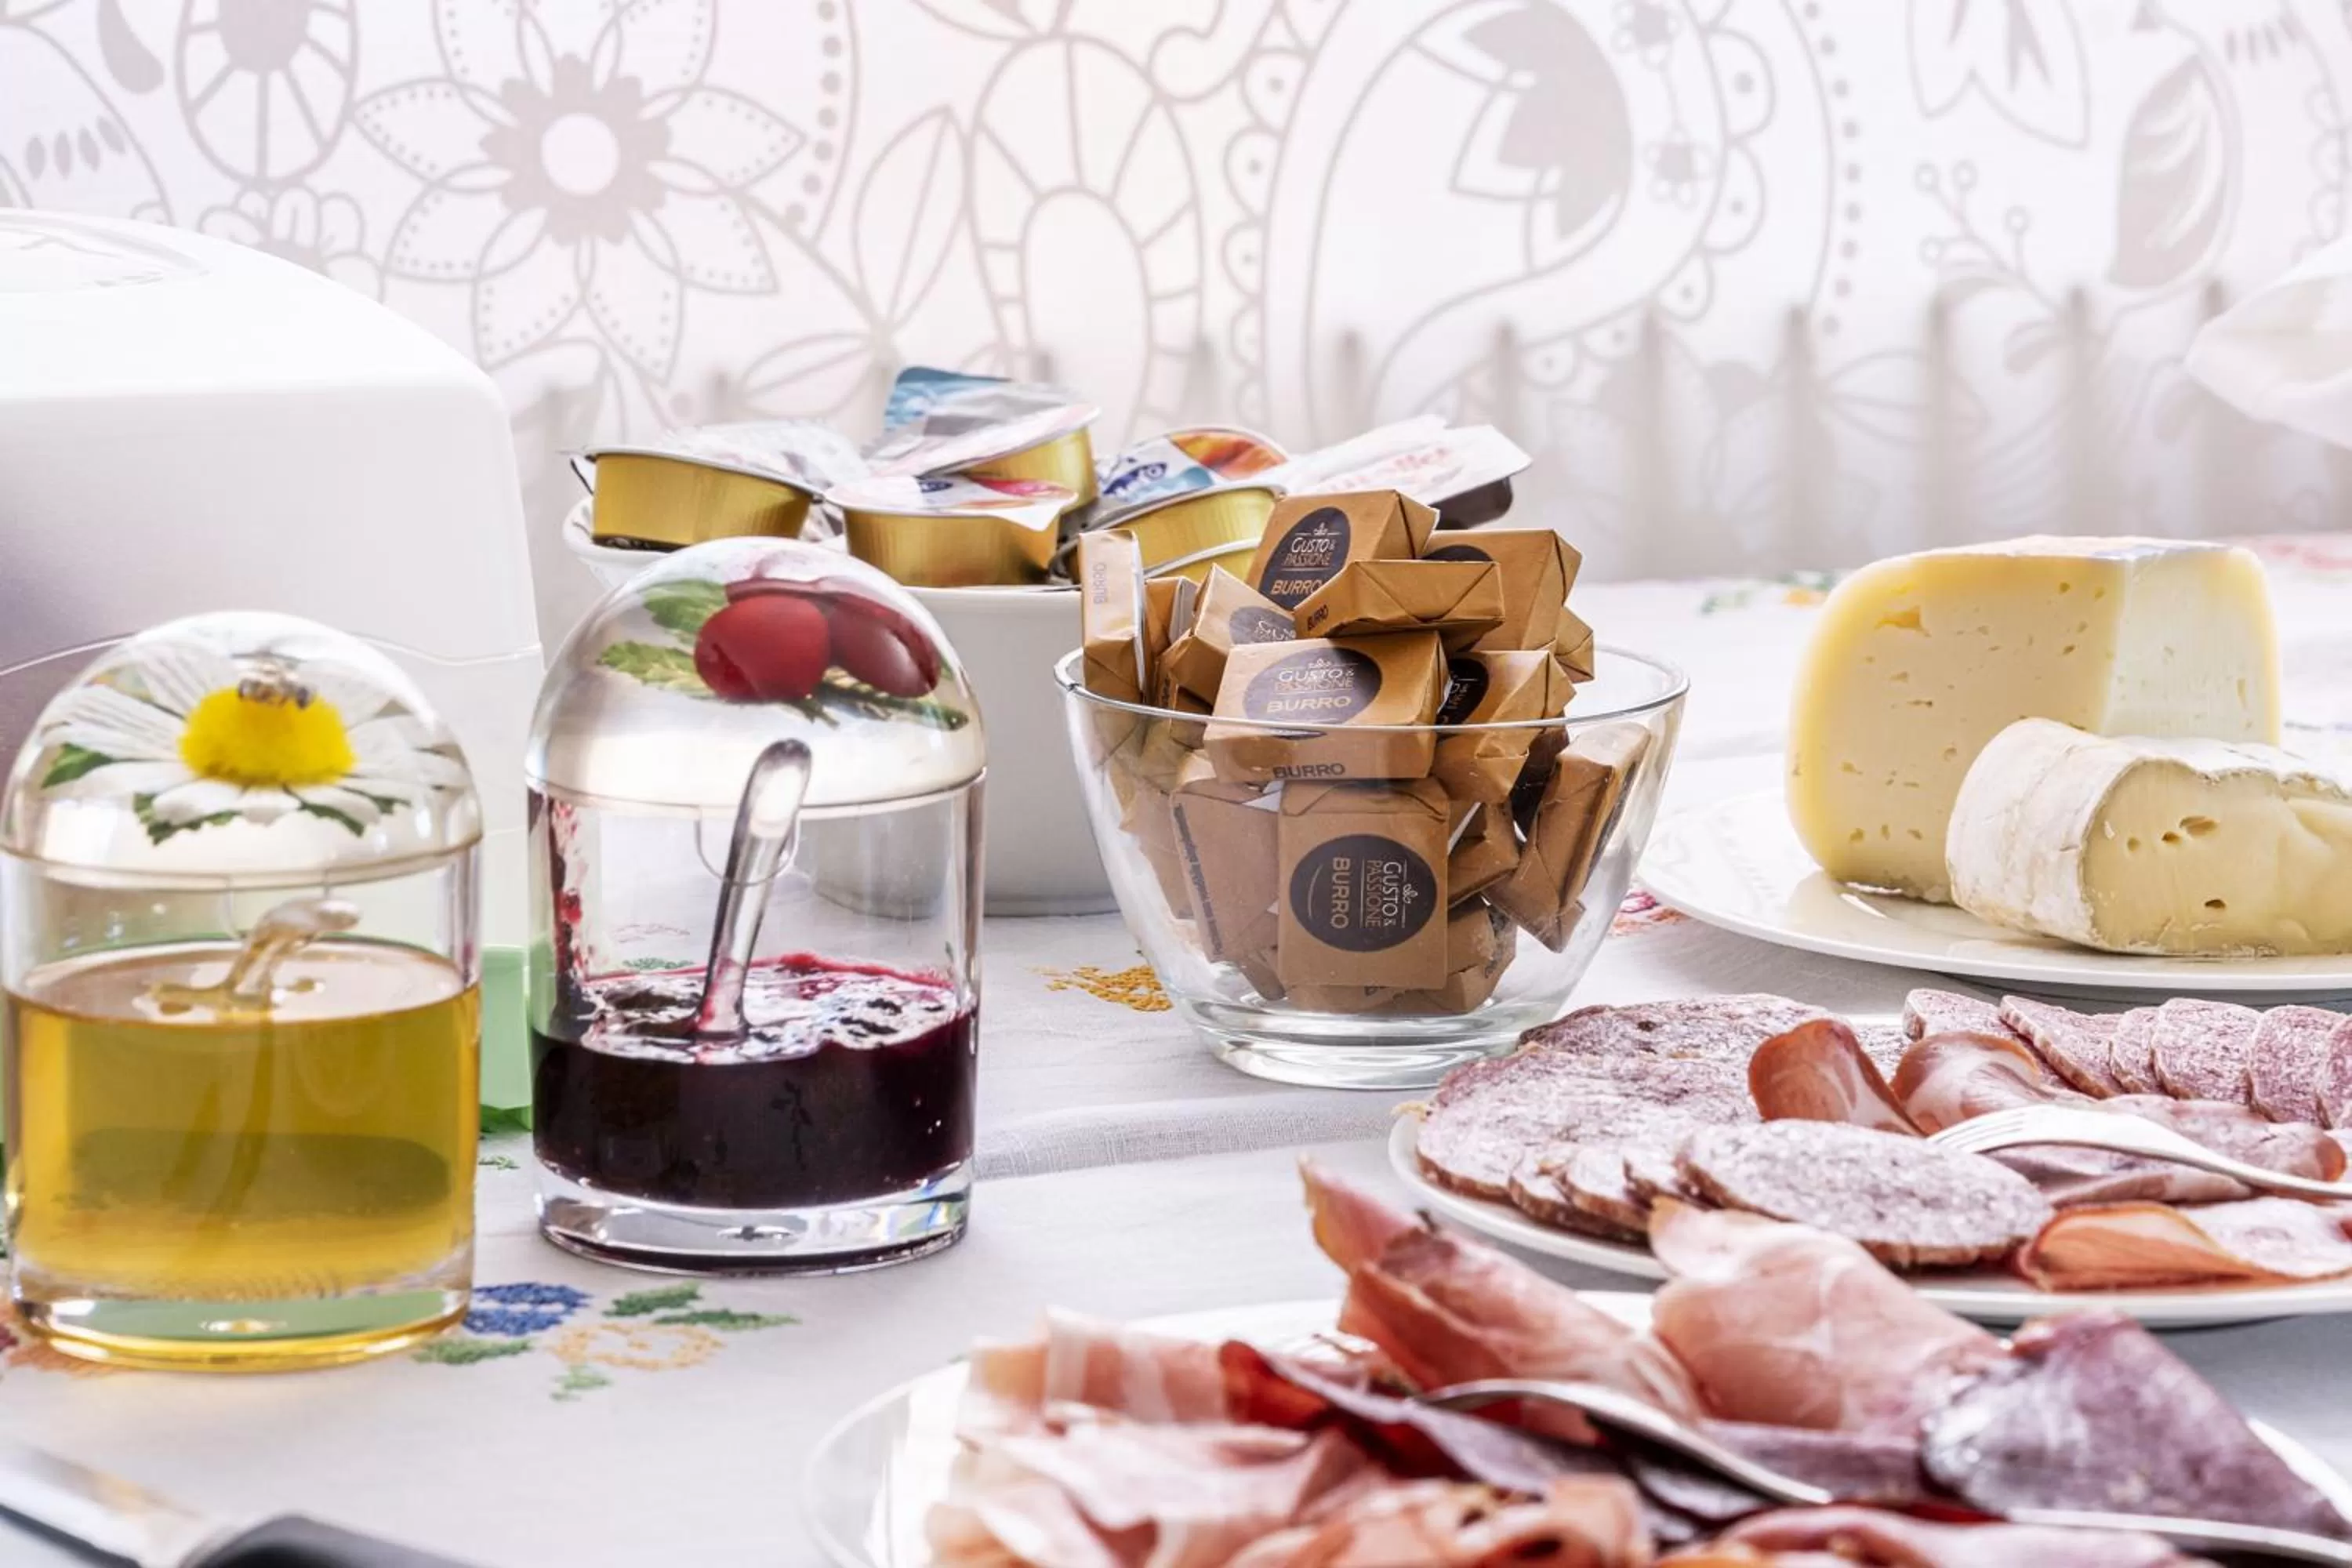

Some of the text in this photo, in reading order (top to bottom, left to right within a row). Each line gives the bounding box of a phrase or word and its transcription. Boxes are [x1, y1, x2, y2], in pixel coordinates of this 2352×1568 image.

[1292, 537, 1330, 553] GUSTO
[1283, 553, 1334, 566] PASSIONE
[1275, 676, 1355, 691] PASSIONE
[1278, 668, 1343, 682] GUSTO
[1266, 695, 1352, 713] BURRO
[1272, 762, 1346, 779] BURRO
[1330, 856, 1352, 929] BURRO
[1364, 859, 1384, 929] PASSIONE
[1382, 861, 1403, 916] GUSTO
